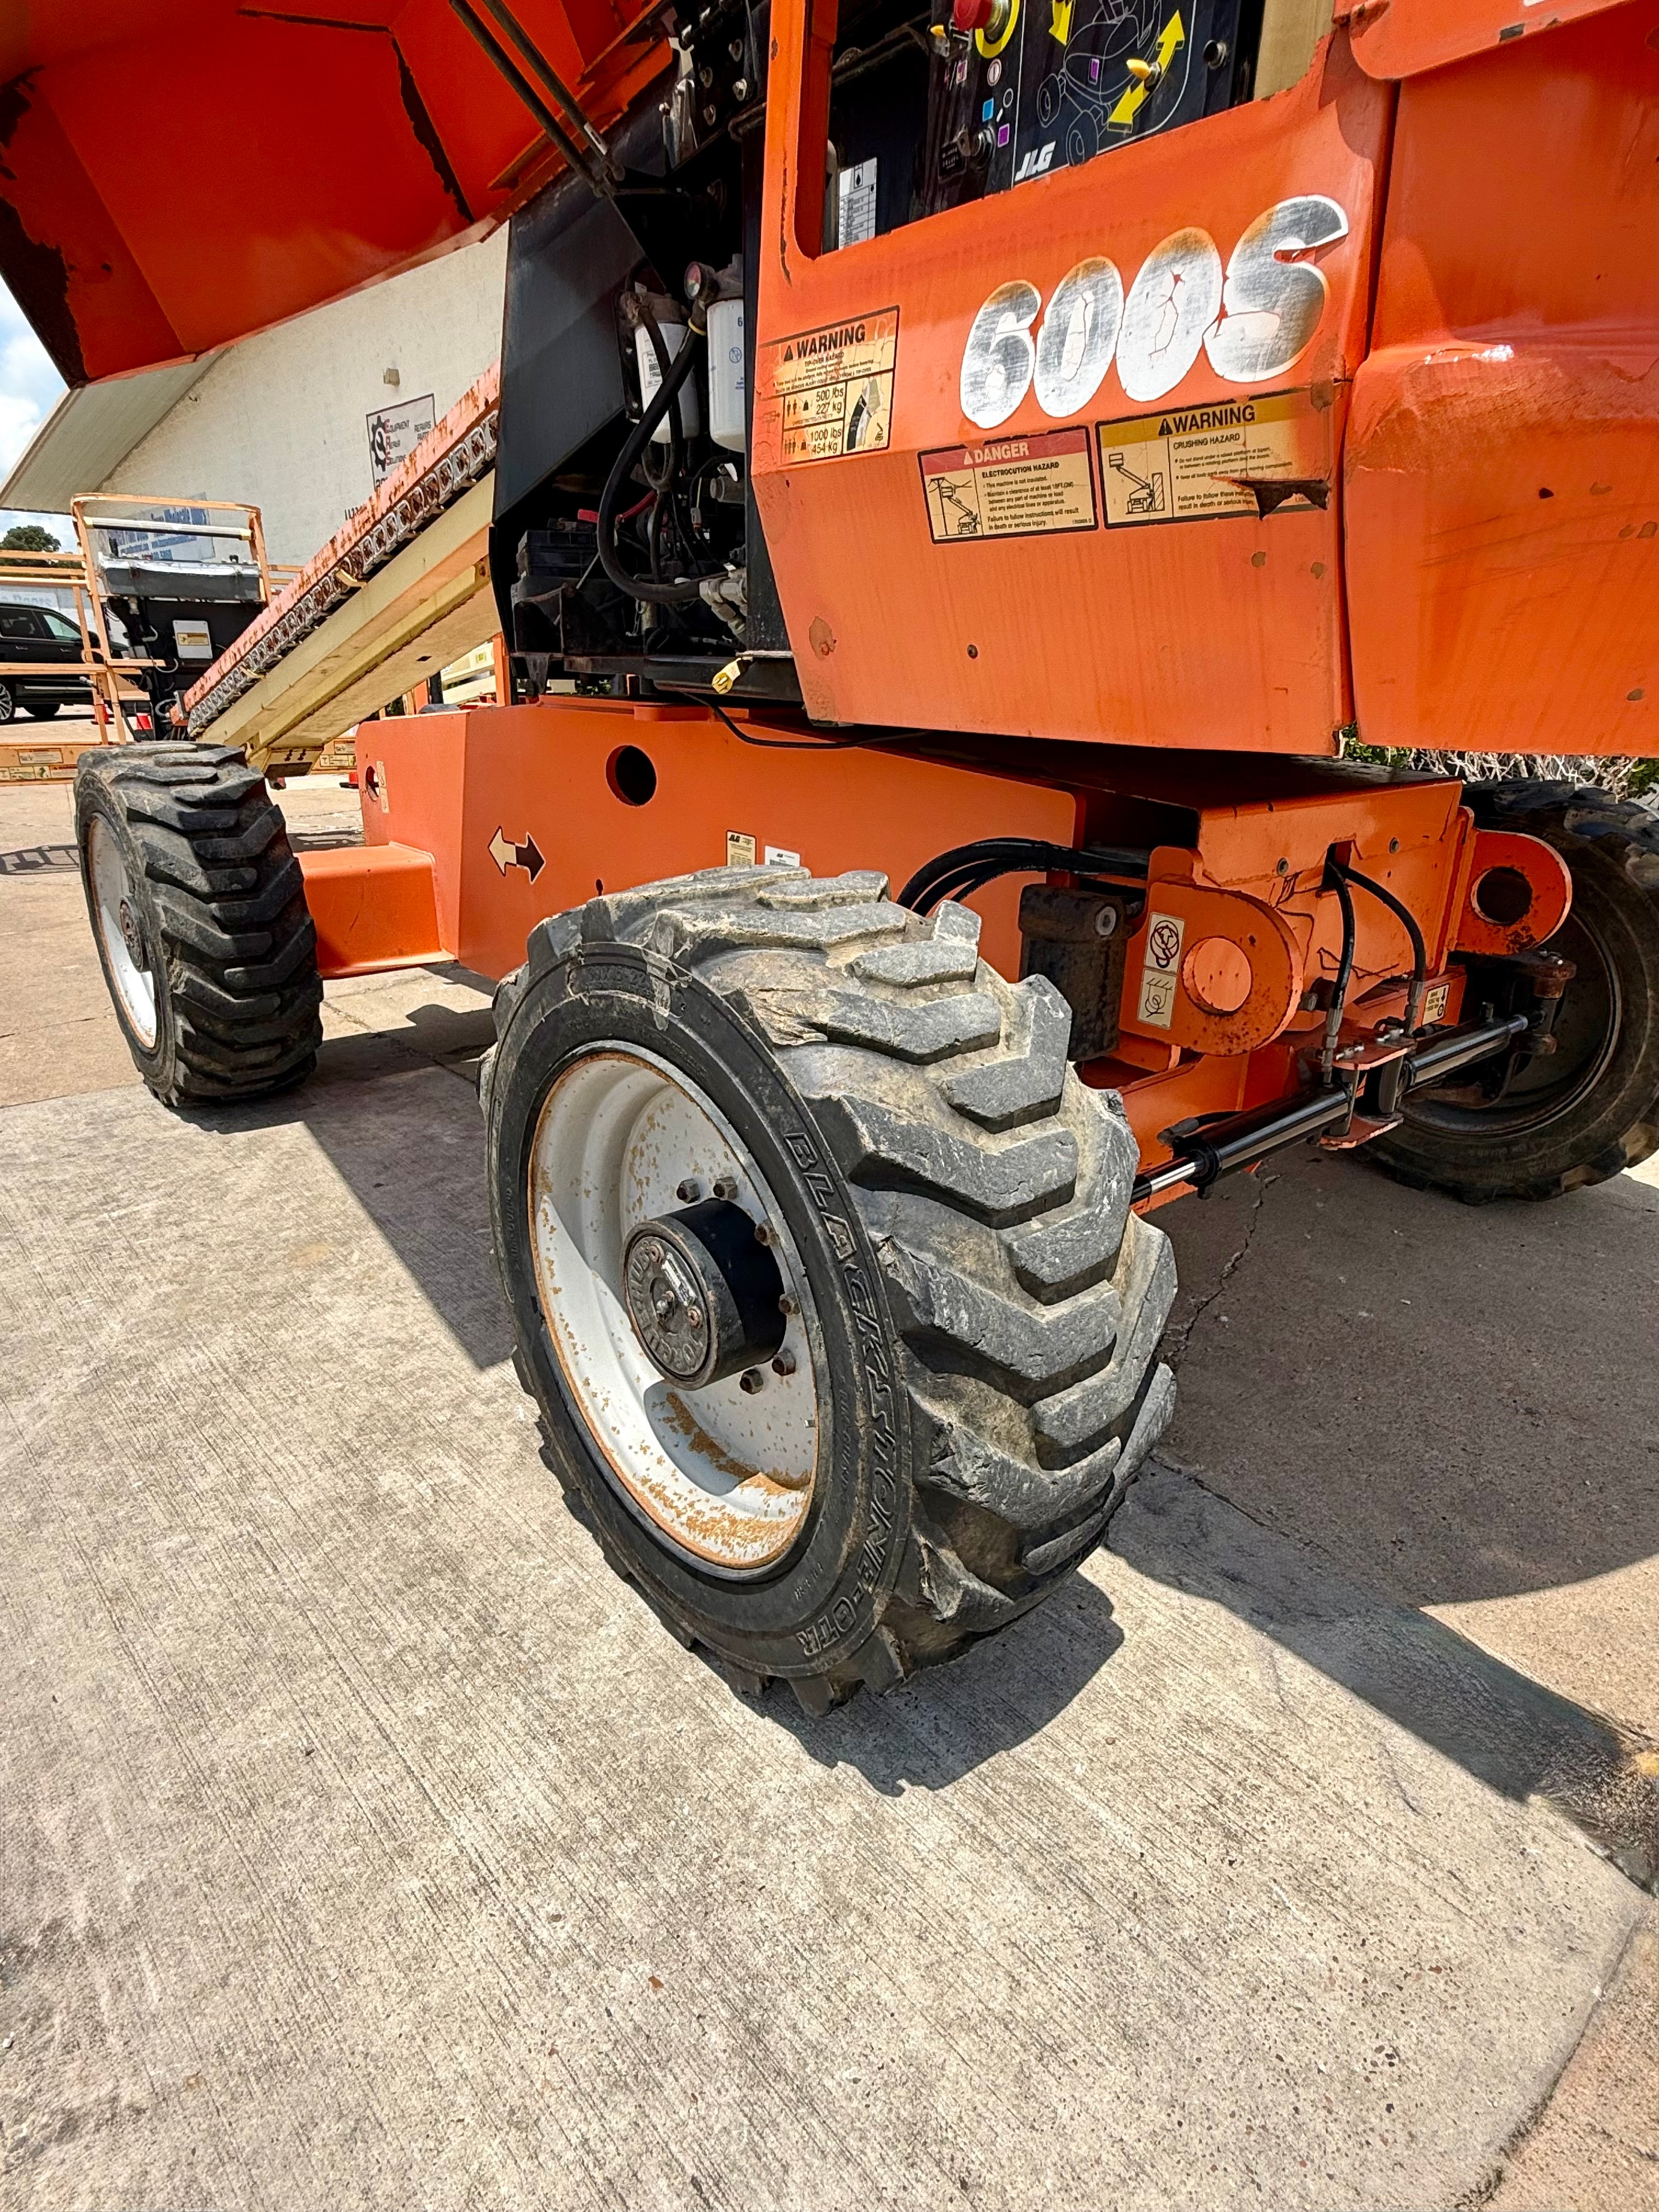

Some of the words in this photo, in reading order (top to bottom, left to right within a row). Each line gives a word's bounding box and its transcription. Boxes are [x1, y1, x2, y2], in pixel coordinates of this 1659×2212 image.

[1014, 141, 1056, 182] JLG
[960, 194, 1349, 429] 600S
[797, 323, 866, 360] WARNING
[816, 388, 830, 402] 500
[832, 386, 844, 397] lbs
[816, 401, 830, 415] 227
[832, 399, 842, 414] kg
[384, 419, 410, 434] EQUIPMENT
[1173, 404, 1255, 433] WARNING
[810, 428, 828, 442] 1000
[830, 426, 842, 438] lbs
[1173, 437, 1209, 450] CRUSHING
[1210, 433, 1240, 445] HAZARD
[812, 440, 826, 454] 454
[828, 440, 838, 454] kg
[975, 442, 1029, 463] DANGER
[982, 465, 1032, 479] ELECTROCUTION
[1033, 461, 1059, 471] HAZARD
[1178, 493, 1195, 502] Failure
[1203, 491, 1219, 500] follow
[1199, 499, 1215, 508] death
